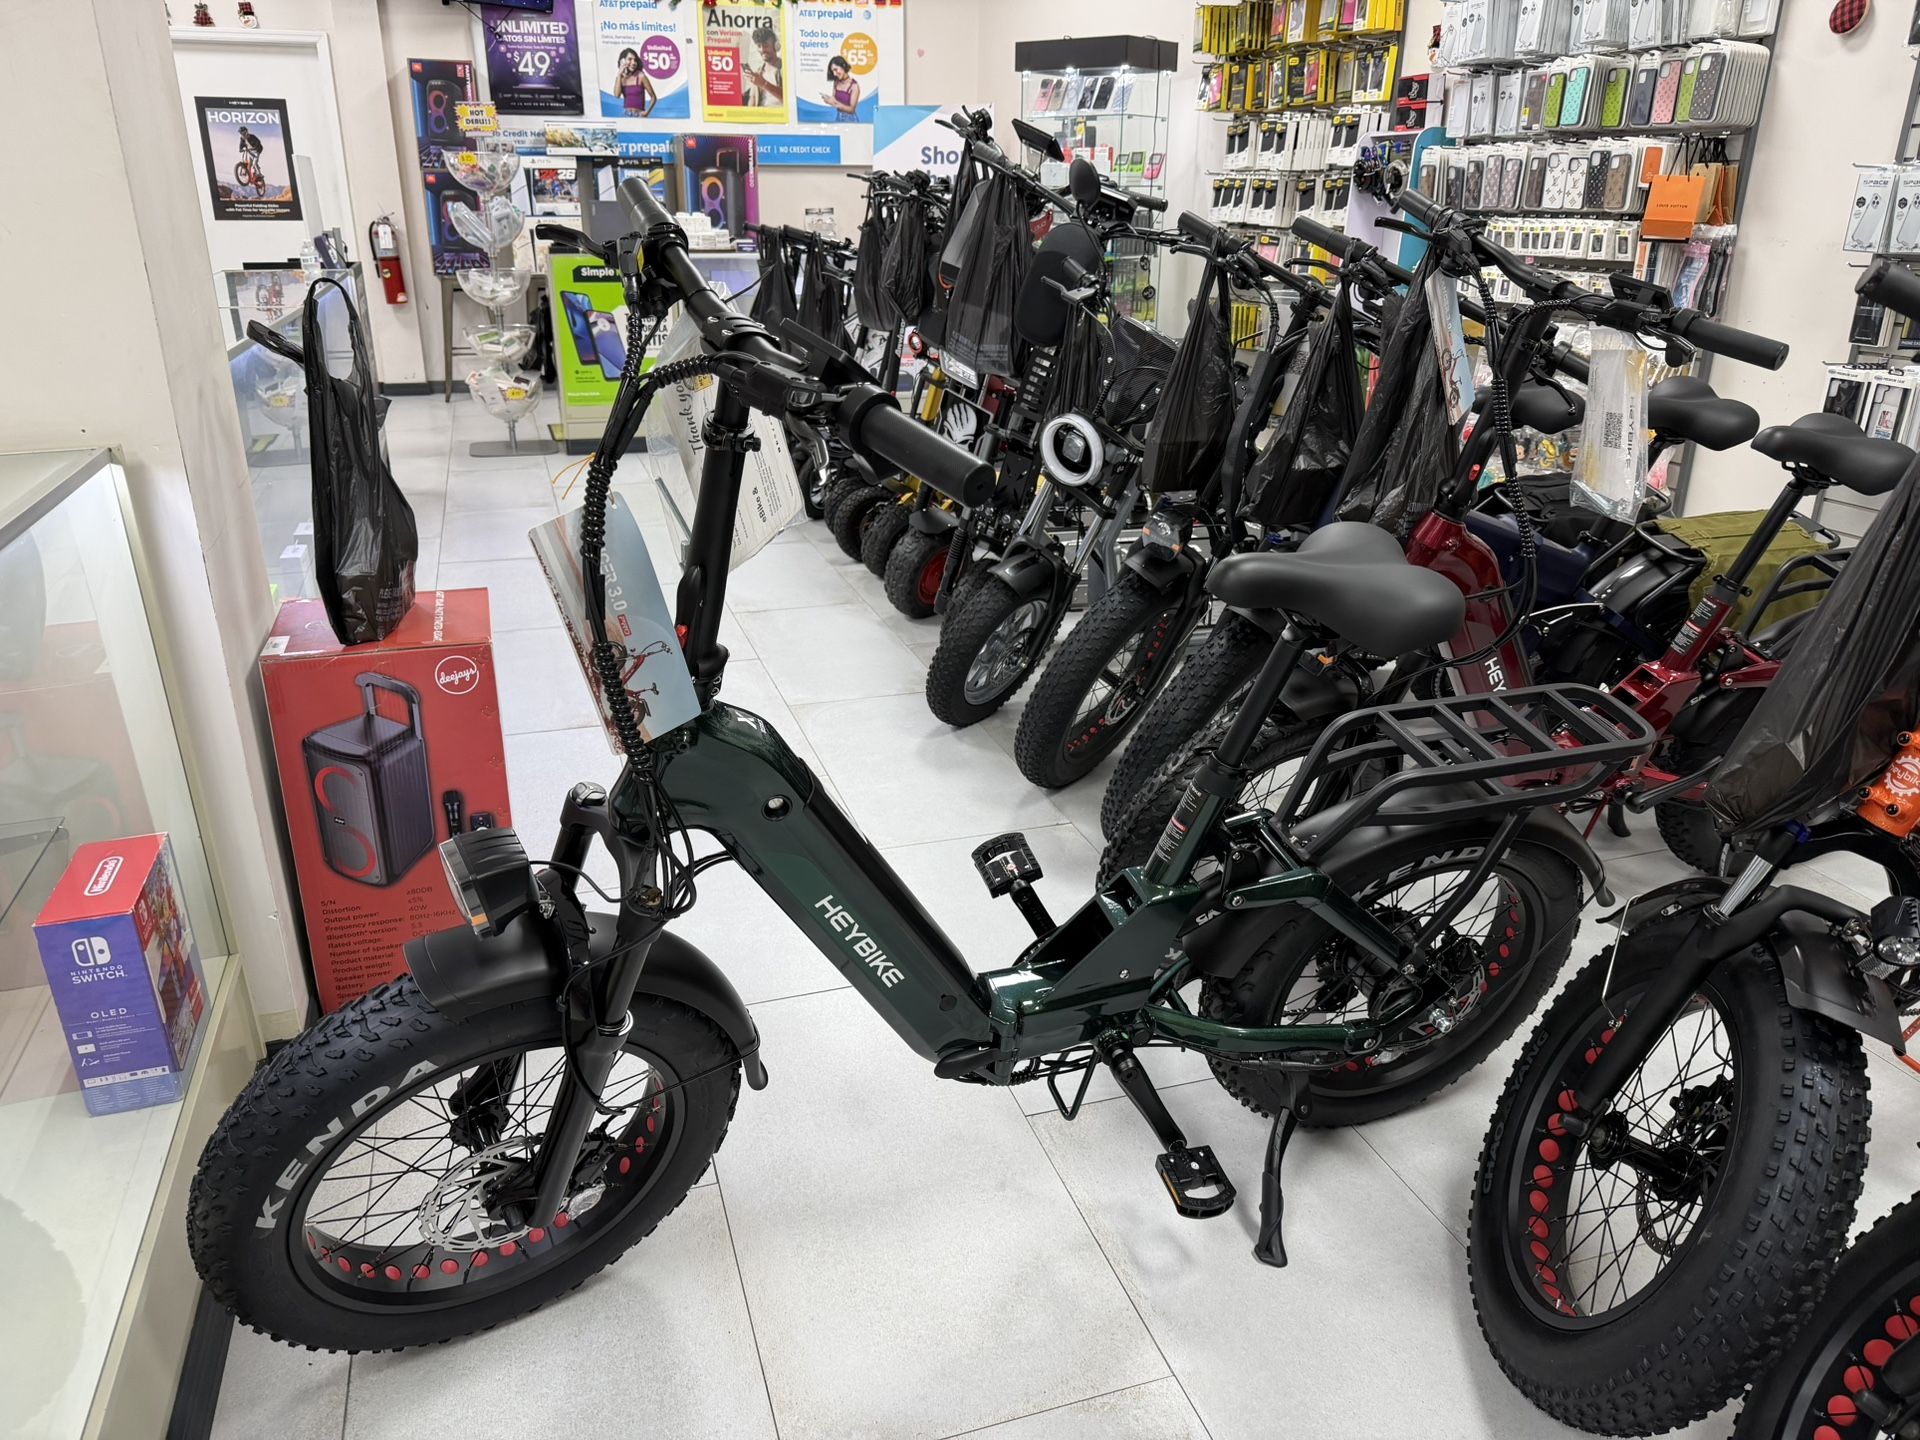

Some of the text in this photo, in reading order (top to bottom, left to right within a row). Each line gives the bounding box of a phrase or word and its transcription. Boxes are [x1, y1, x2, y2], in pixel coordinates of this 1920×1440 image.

[707, 10, 774, 28] Ahorra
[818, 10, 853, 20] prepaid
[620, 21, 640, 30] más
[642, 22, 676, 32] límites!
[524, 35, 537, 43] SIN
[800, 29, 844, 42] Todo lo que
[800, 40, 829, 49] quieres
[513, 51, 550, 76] $49
[644, 52, 670, 70] $50
[708, 57, 733, 71] $50
[207, 111, 280, 124] HORIZON
[502, 130, 528, 138] Credit
[779, 146, 788, 154] NO
[581, 268, 615, 278] Simple
[679, 406, 703, 455] Thank
[607, 586, 628, 611] 3.0
[440, 667, 476, 685] deejays
[1484, 656, 1507, 692] HEY
[90, 860, 118, 892] Nintendo
[1351, 845, 1511, 902] KEND
[324, 915, 351, 924] Output
[325, 922, 366, 932] Frequency
[328, 940, 351, 949] Rated
[814, 894, 905, 988] HEYBIKE
[329, 948, 360, 958] Number
[331, 957, 362, 966] Product
[70, 964, 123, 976] NINTENDO
[332, 965, 363, 974] Product
[72, 969, 125, 984] SWITCH
[334, 974, 365, 983] Speaker
[90, 1007, 127, 1019] OLED
[1483, 1030, 1549, 1194] CHAO YANG
[255, 1059, 439, 1228] KENDA
